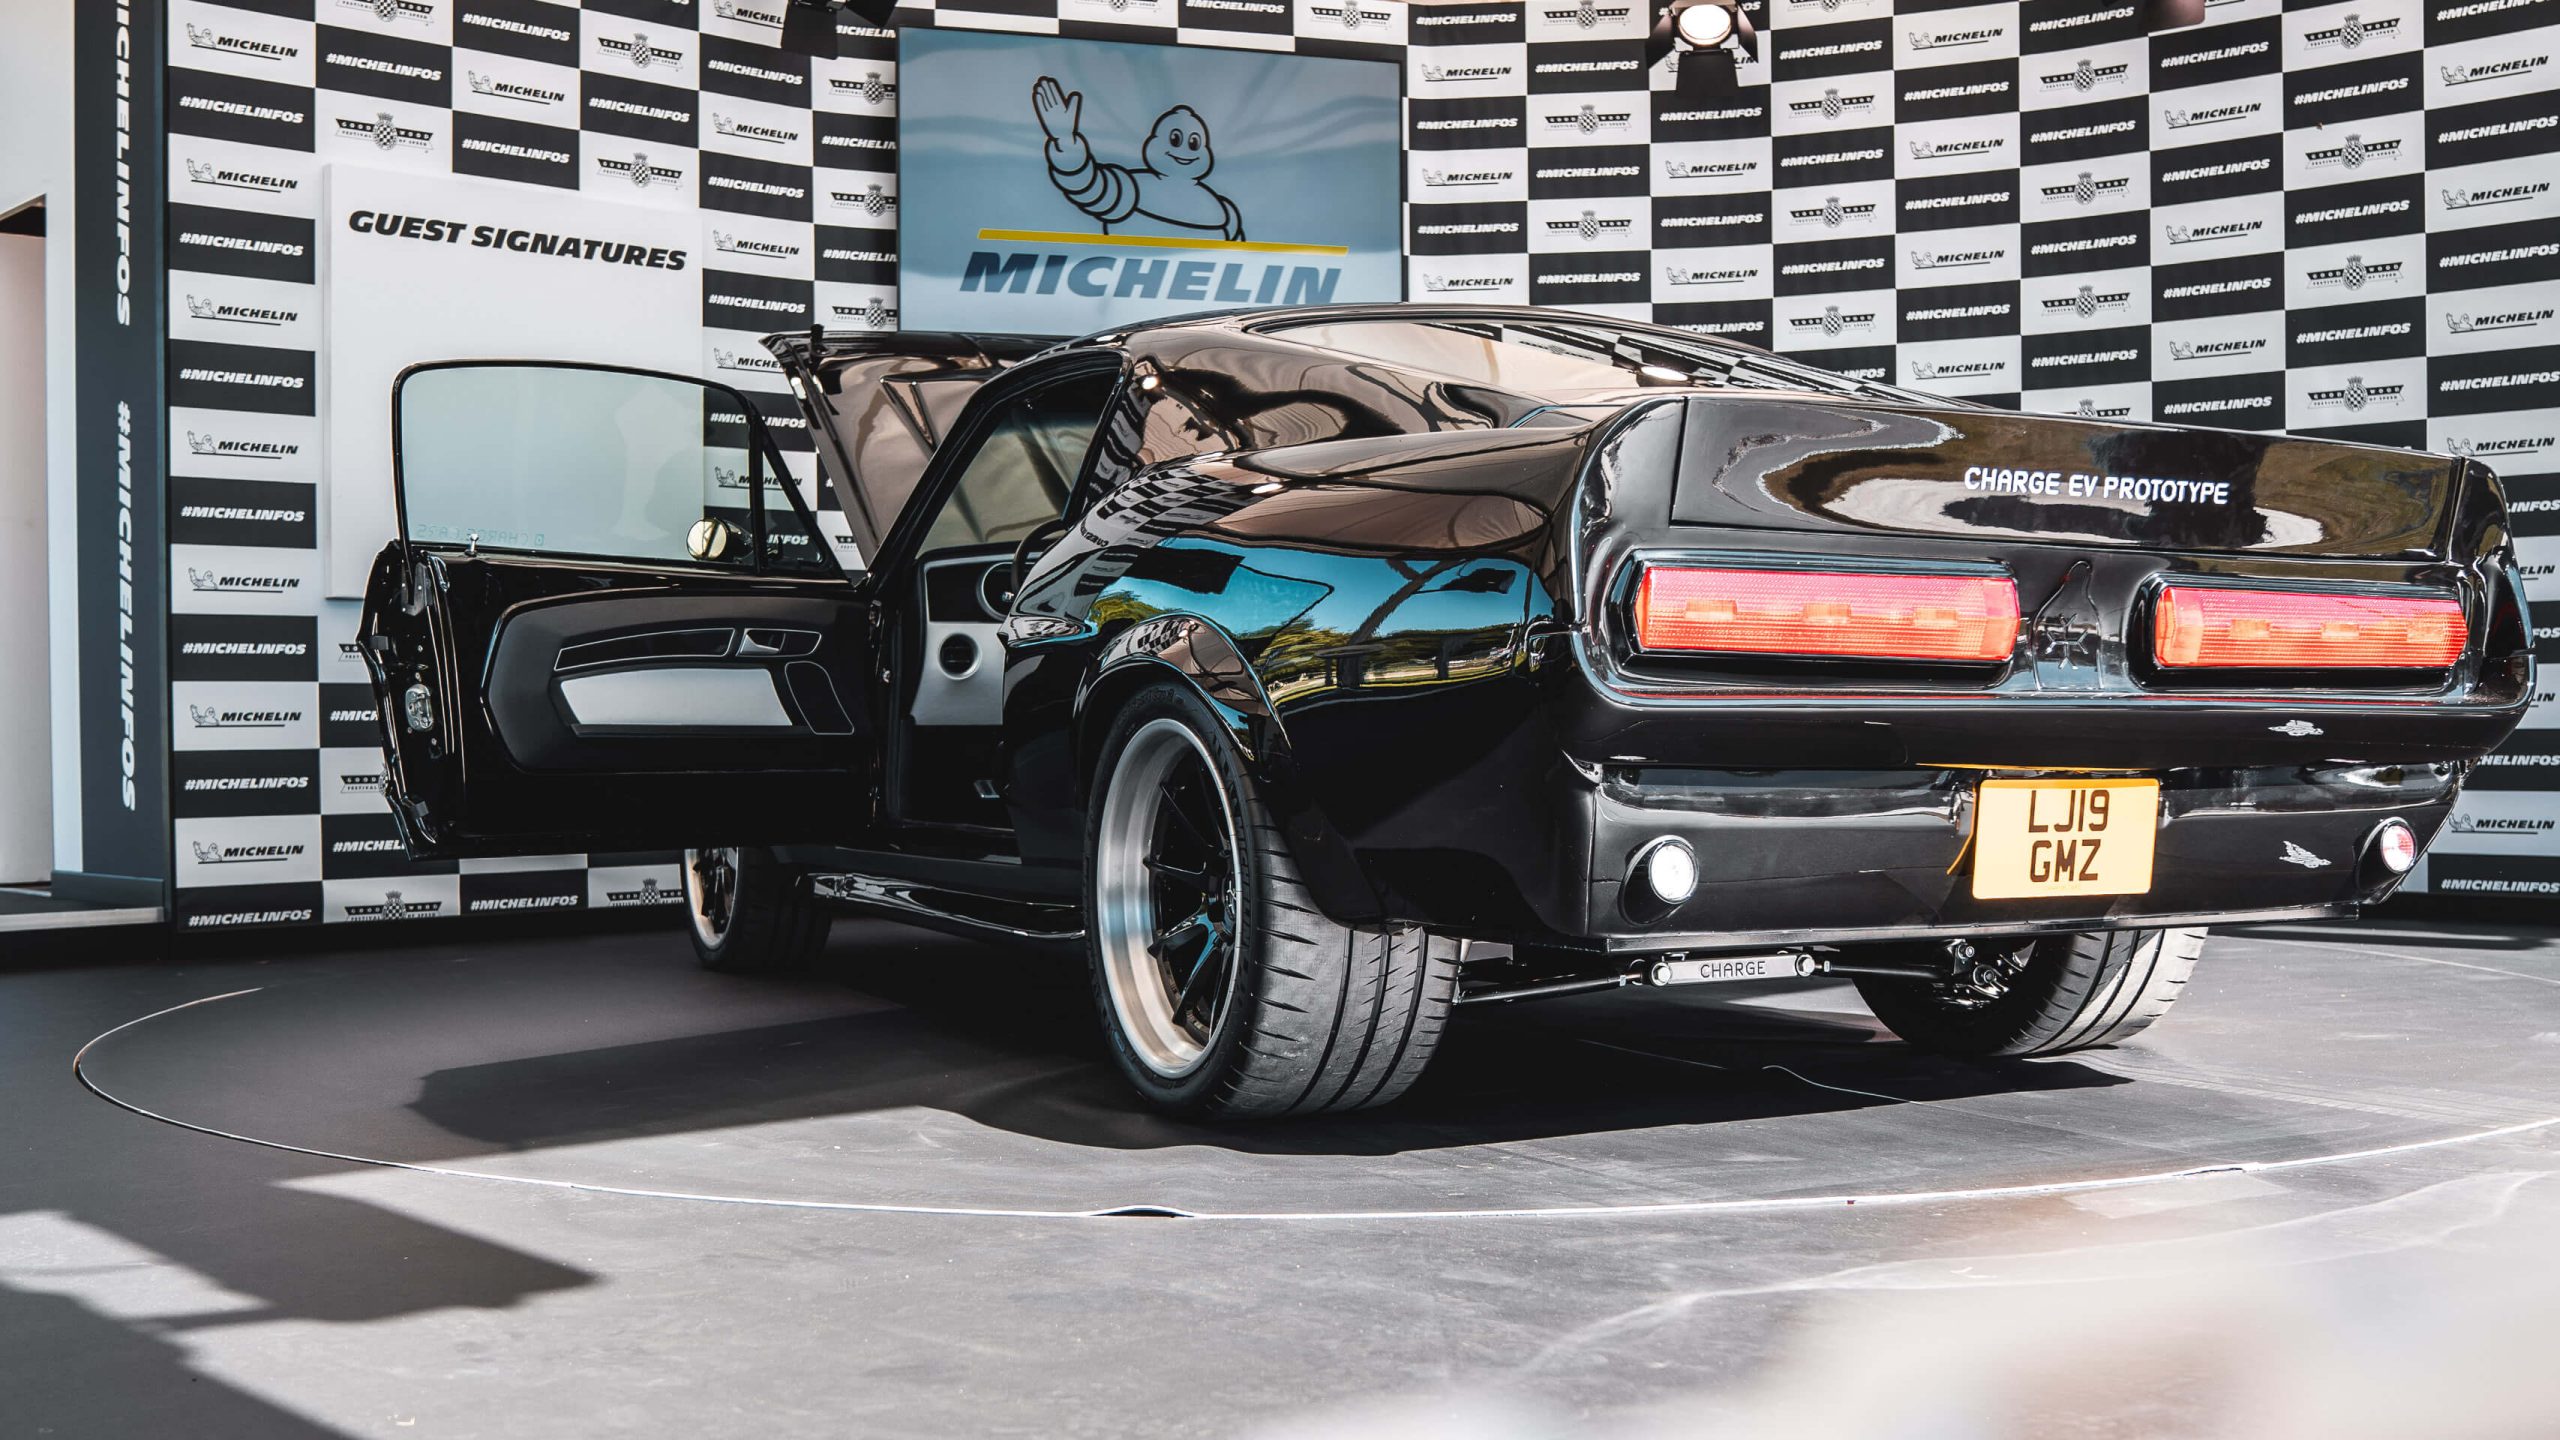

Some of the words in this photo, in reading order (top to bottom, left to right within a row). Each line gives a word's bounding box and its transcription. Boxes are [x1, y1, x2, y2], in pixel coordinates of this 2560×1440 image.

[736, 8, 782, 24] MICHEL
[1416, 13, 1517, 26] #MICHELINFOS
[2029, 6, 2134, 32] #MICHELINFOS
[462, 13, 570, 41] #MICHELINFOS
[1934, 28, 2003, 43] MICHELIN
[217, 36, 298, 57] MICHELIN
[1779, 40, 1883, 60] #MICHELINFOS
[2161, 41, 2269, 68] #MICHELINFOS
[326, 53, 442, 81] #MICHELINFOS
[708, 60, 803, 85] #MICHELINFOS
[1446, 67, 1512, 77] MICHELIN
[1535, 60, 1639, 73] #MICHELINFOS
[2470, 55, 2549, 77] MICHELIN
[495, 83, 565, 102] MICHELIN
[1904, 81, 2009, 101] #MICHELINFOS
[2294, 78, 2409, 105] #MICHELINFOS
[180, 96, 304, 123] #MICHELINFOS
[589, 97, 690, 122] #MICHELINFOS
[1659, 107, 1762, 121] #MICHELINFOS
[2191, 103, 2261, 121] MICHELIN
[736, 124, 798, 141] MICHELIN
[1417, 118, 1518, 130] #MICHELINFOS
[2030, 120, 2136, 143] #MICHELINFOS
[2438, 115, 2559, 143] #MICHELINFOS
[462, 139, 570, 163] #MICHELINFOS
[1935, 139, 2004, 153] MICHELIN
[116, 0, 130, 326] ICHELINFOS
[1780, 149, 1884, 167] #MICHELINFOS
[1447, 172, 1513, 181] MICHELIN
[1536, 166, 1640, 178] #MICHELINFOS
[1691, 162, 1757, 173] MICHELIN
[2162, 158, 2270, 182] #MICHELINFOS
[217, 171, 298, 189] MICHELIN
[708, 176, 804, 198] #MICHELINFOS
[2471, 182, 2550, 201] MICHELIN
[1905, 192, 2010, 210] #MICHELINFOS
[1660, 213, 1763, 227] #MICHELINFOS
[2295, 200, 2410, 224] #MICHELINFOS
[1417, 223, 1519, 234] #MICHELINFOS
[2192, 221, 2262, 237] MICHELIN
[179, 232, 304, 256] #MICHELINFOS
[348, 209, 468, 244] GUEST
[471, 224, 687, 272] SIGNATURES
[736, 240, 799, 255] MICHELIN
[2031, 234, 2137, 255] #MICHELINFOS
[1936, 250, 2005, 263] MICHELIN
[2439, 243, 2560, 268] #MICHELINFOS
[1691, 269, 1758, 280] MICHELIN
[1782, 258, 1885, 275] #MICHELINFOS
[959, 250, 1341, 305] MICHELIN
[1448, 278, 1513, 287] MICHELIN
[1537, 272, 1641, 284] #MICHELINFOS
[2163, 277, 2272, 299] #MICHELINFOS
[708, 294, 806, 313] #MICHELINFOS
[1906, 304, 2011, 321] #MICHELINFOS
[217, 306, 298, 321] MICHELIN
[2475, 309, 2554, 326] MICHELIN
[2296, 323, 2411, 344] #MICHELINFOS
[2195, 339, 2266, 353] MICHELIN
[2031, 349, 2138, 367] #MICHELINFOS
[1937, 362, 2005, 374] MICHELIN
[180, 368, 304, 388] #MICHELINFOS
[2164, 396, 2272, 414] #MICHELINFOS
[218, 441, 298, 454] MICHELIN
[2476, 437, 2555, 451] MICHELIN
[1964, 467, 2061, 496] CHARGE
[2068, 474, 2099, 497] EV
[2103, 476, 2230, 505] PROTOTYPE
[181, 506, 305, 522] #MICHELINFOS
[219, 577, 300, 588] MICHELIN
[117, 400, 136, 812] #MICHELINFOS
[182, 643, 306, 655] #MICHELINFOS
[221, 712, 302, 721] MICHELIN
[185, 777, 309, 790] #MICHELINFOS
[2028, 789, 2110, 833] LJ19
[2476, 819, 2555, 829] MICHELIN
[224, 845, 304, 857] MICHELIN
[333, 840, 405, 852] #MICHEL
[2030, 839, 2101, 883] GMZ
[470, 895, 578, 910] #MICHELINFOS
[188, 909, 312, 926] #MICHELINFOS
[1700, 961, 1766, 978] CHARGE
